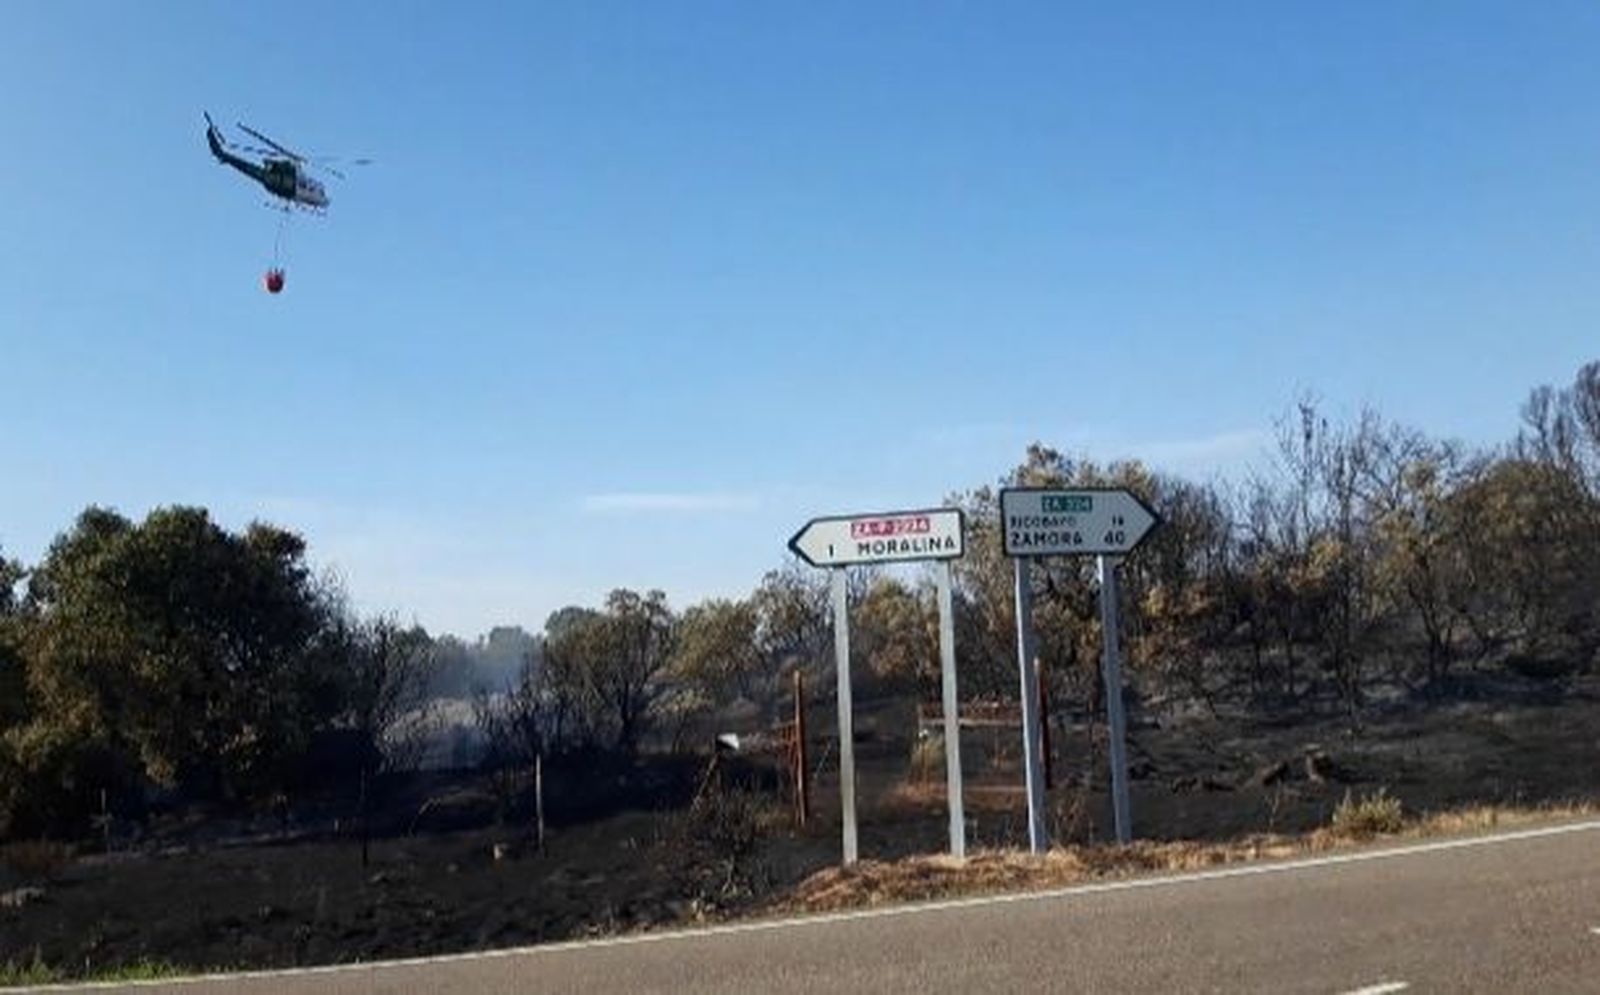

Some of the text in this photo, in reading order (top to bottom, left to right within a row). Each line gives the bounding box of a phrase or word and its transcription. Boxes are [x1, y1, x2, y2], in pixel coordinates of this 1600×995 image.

[857, 535, 955, 556] MORALINA
[1010, 531, 1125, 547] ZAMORA 40
